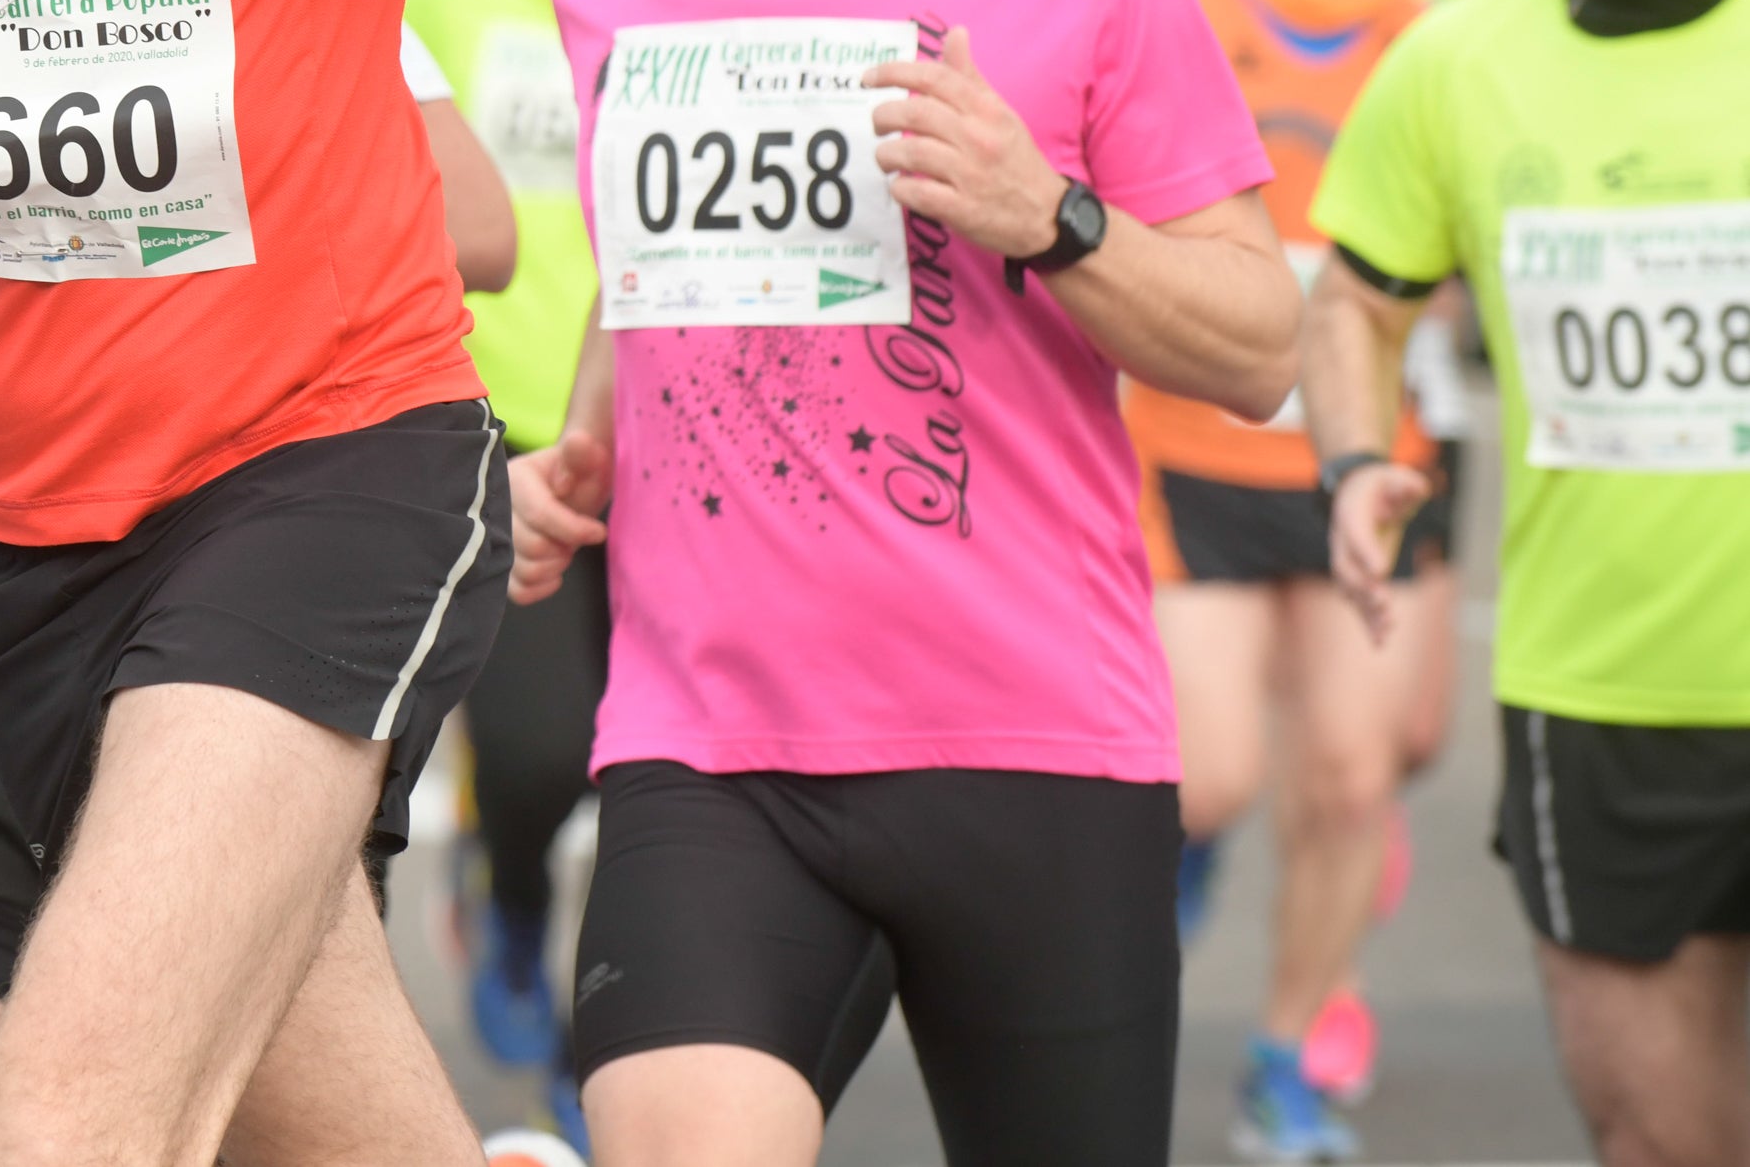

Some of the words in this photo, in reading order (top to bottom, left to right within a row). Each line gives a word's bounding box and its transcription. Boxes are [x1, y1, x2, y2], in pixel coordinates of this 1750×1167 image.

[23, 58, 30, 68] 9
[33, 56, 46, 68] de
[48, 53, 90, 67] febrero
[92, 53, 105, 64] de
[611, 41, 713, 111] XXIII
[636, 128, 854, 234] 0258
[7, 207, 22, 220] el
[27, 205, 83, 222] barrio,
[88, 207, 133, 221] como
[139, 205, 159, 218] en
[152, 237, 176, 248] Corte
[1554, 302, 1750, 390] 0038
